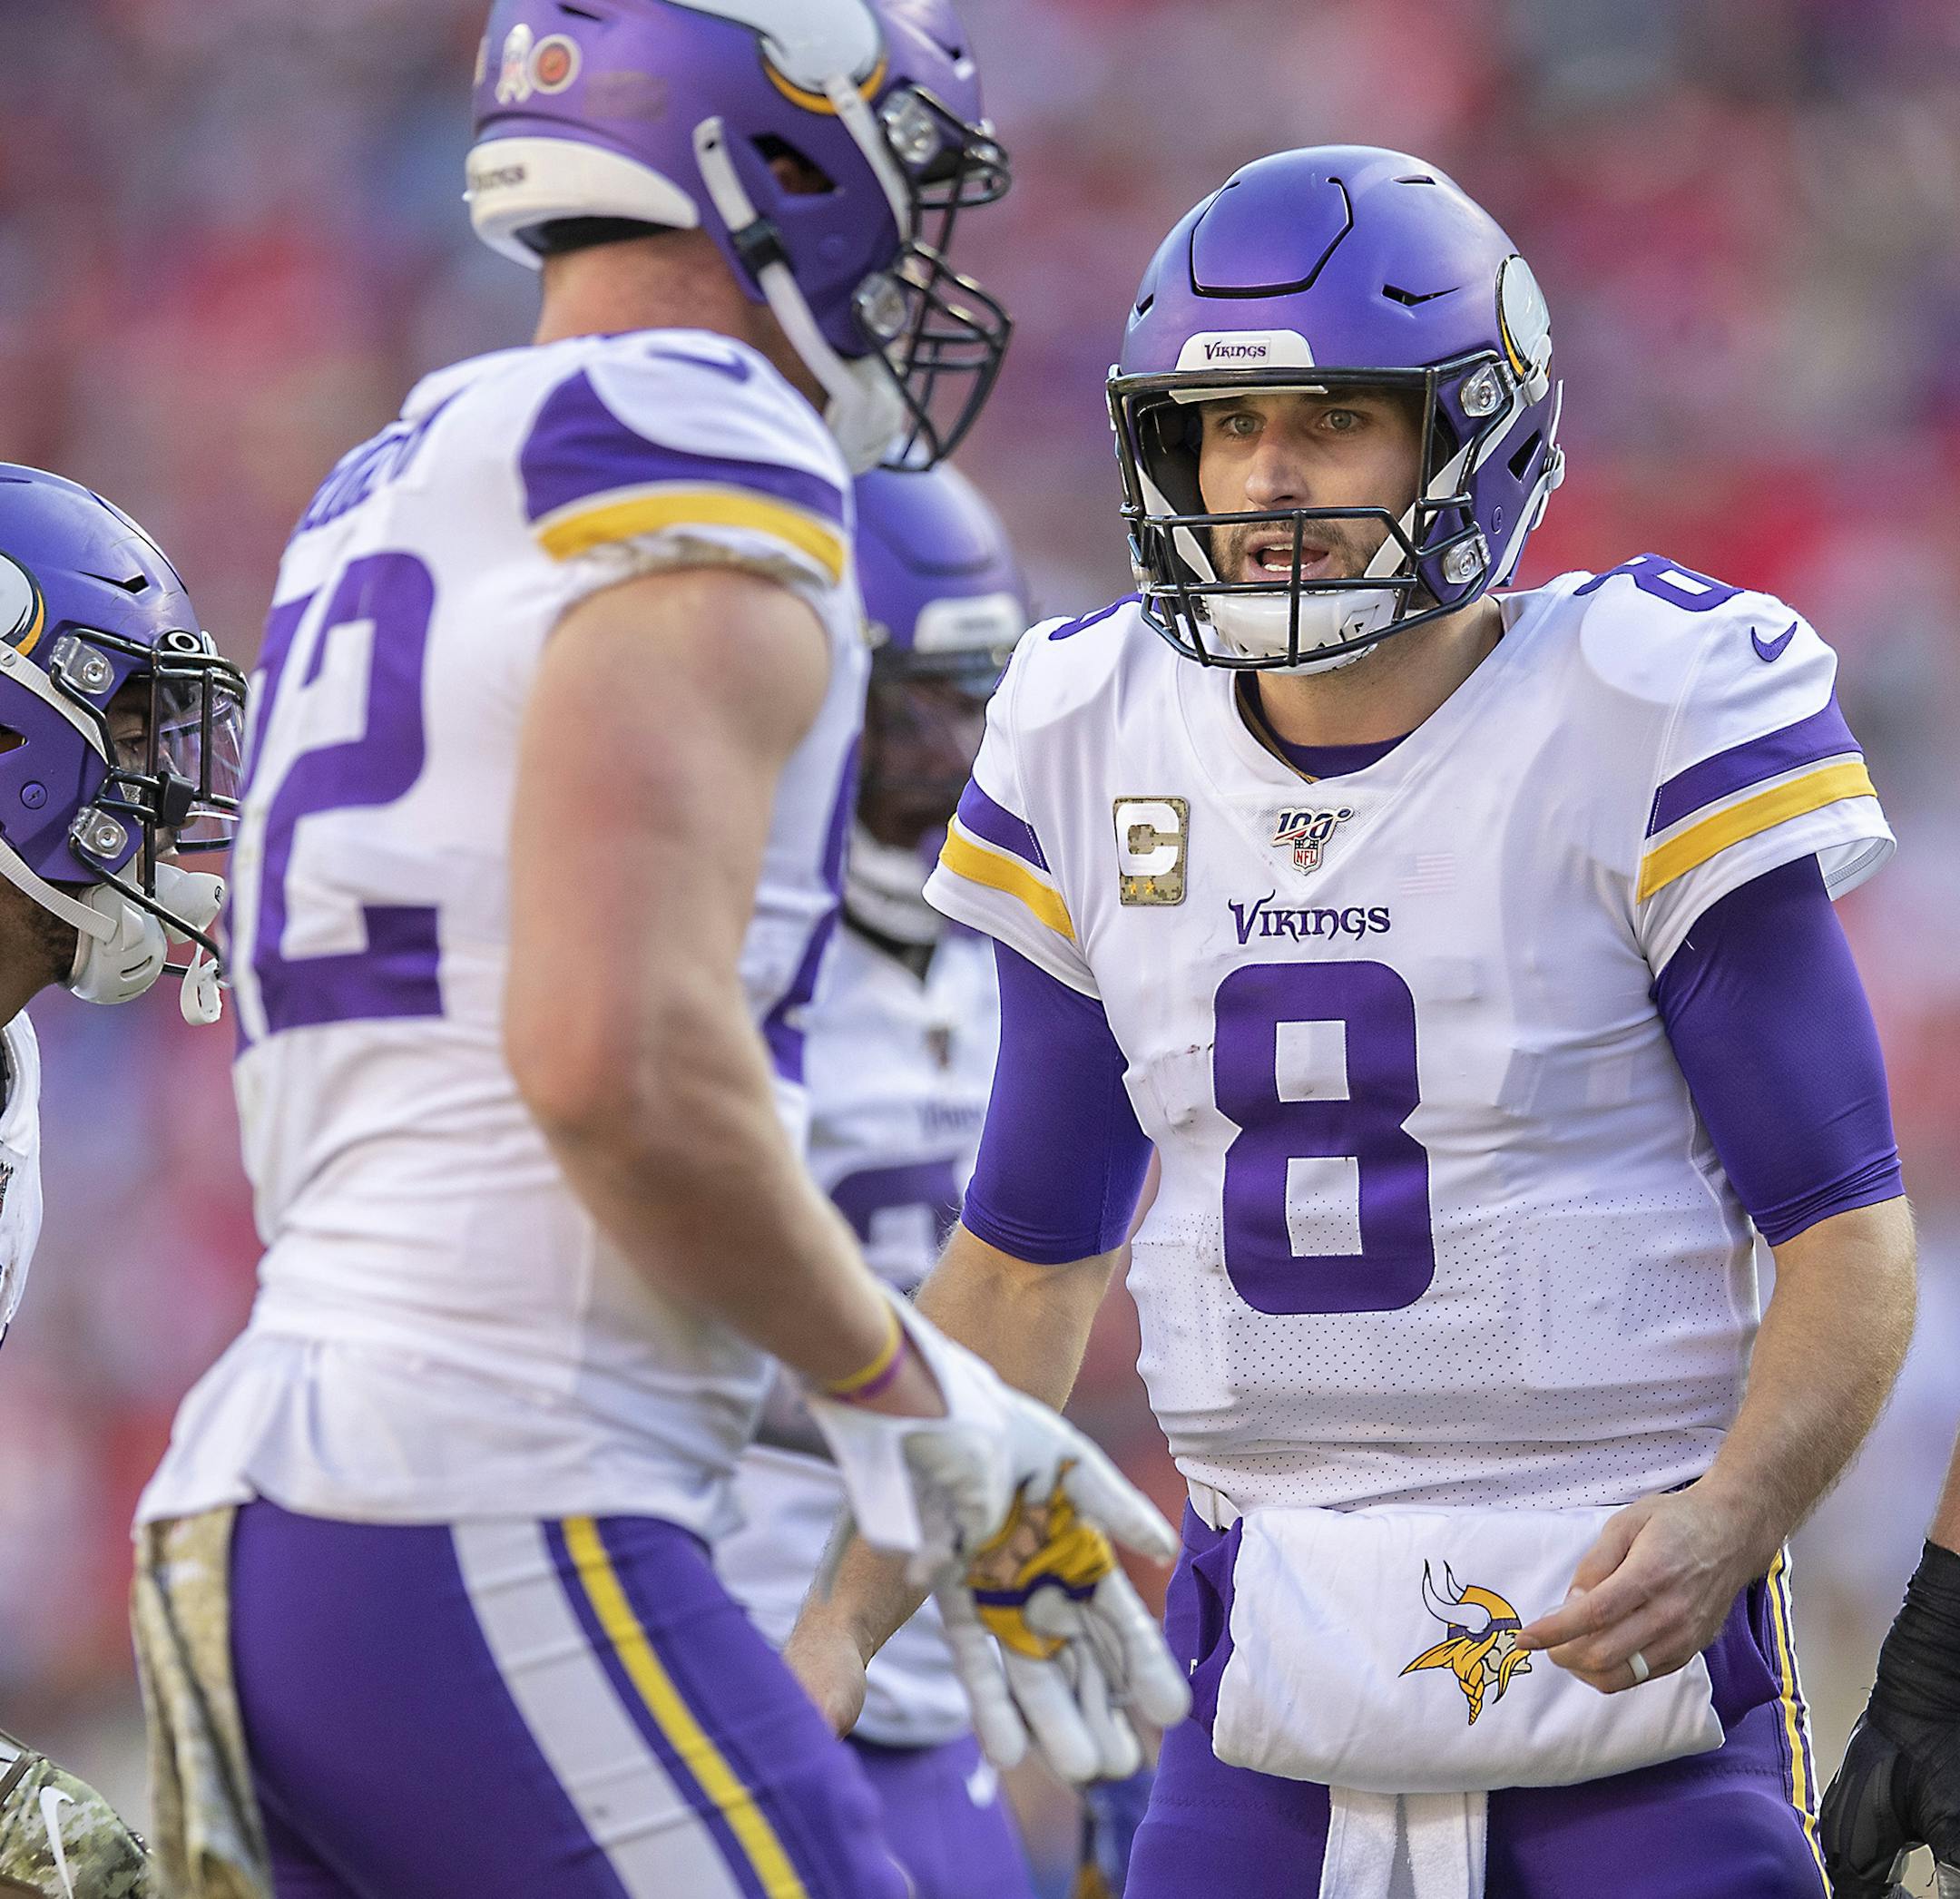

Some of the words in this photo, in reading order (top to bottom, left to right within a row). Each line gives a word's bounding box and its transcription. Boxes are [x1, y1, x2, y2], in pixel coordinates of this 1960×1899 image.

[1204, 341, 1267, 360] VIKINGS
[1115, 802, 1180, 876] C
[1297, 850, 1316, 866] NFL
[1228, 889, 1391, 945] VIKINGS
[1212, 959, 1436, 1316] 8
